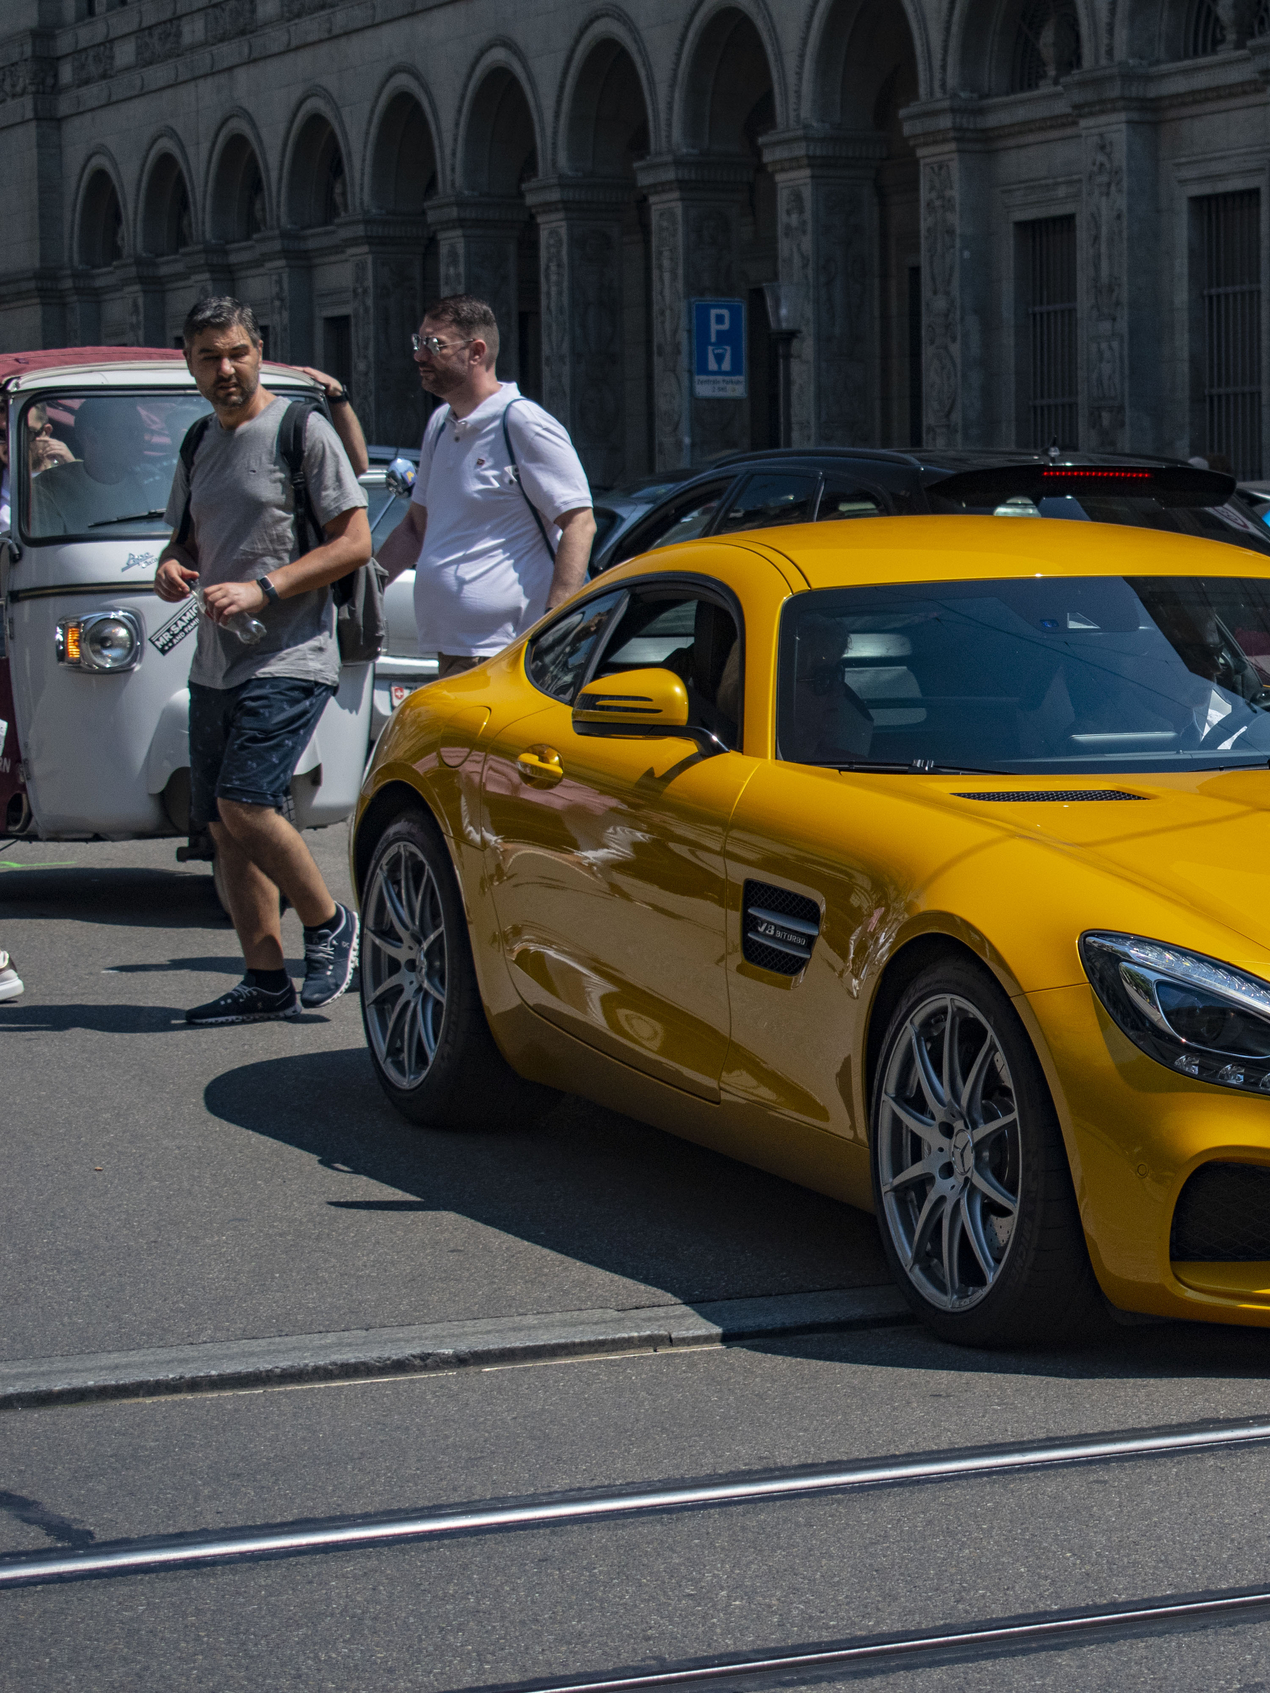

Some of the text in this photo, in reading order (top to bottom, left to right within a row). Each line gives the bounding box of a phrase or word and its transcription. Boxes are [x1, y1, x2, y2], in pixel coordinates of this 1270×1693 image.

[710, 308, 730, 343] P
[172, 631, 186, 646] AND
[757, 922, 806, 946] V8 BITURBO
